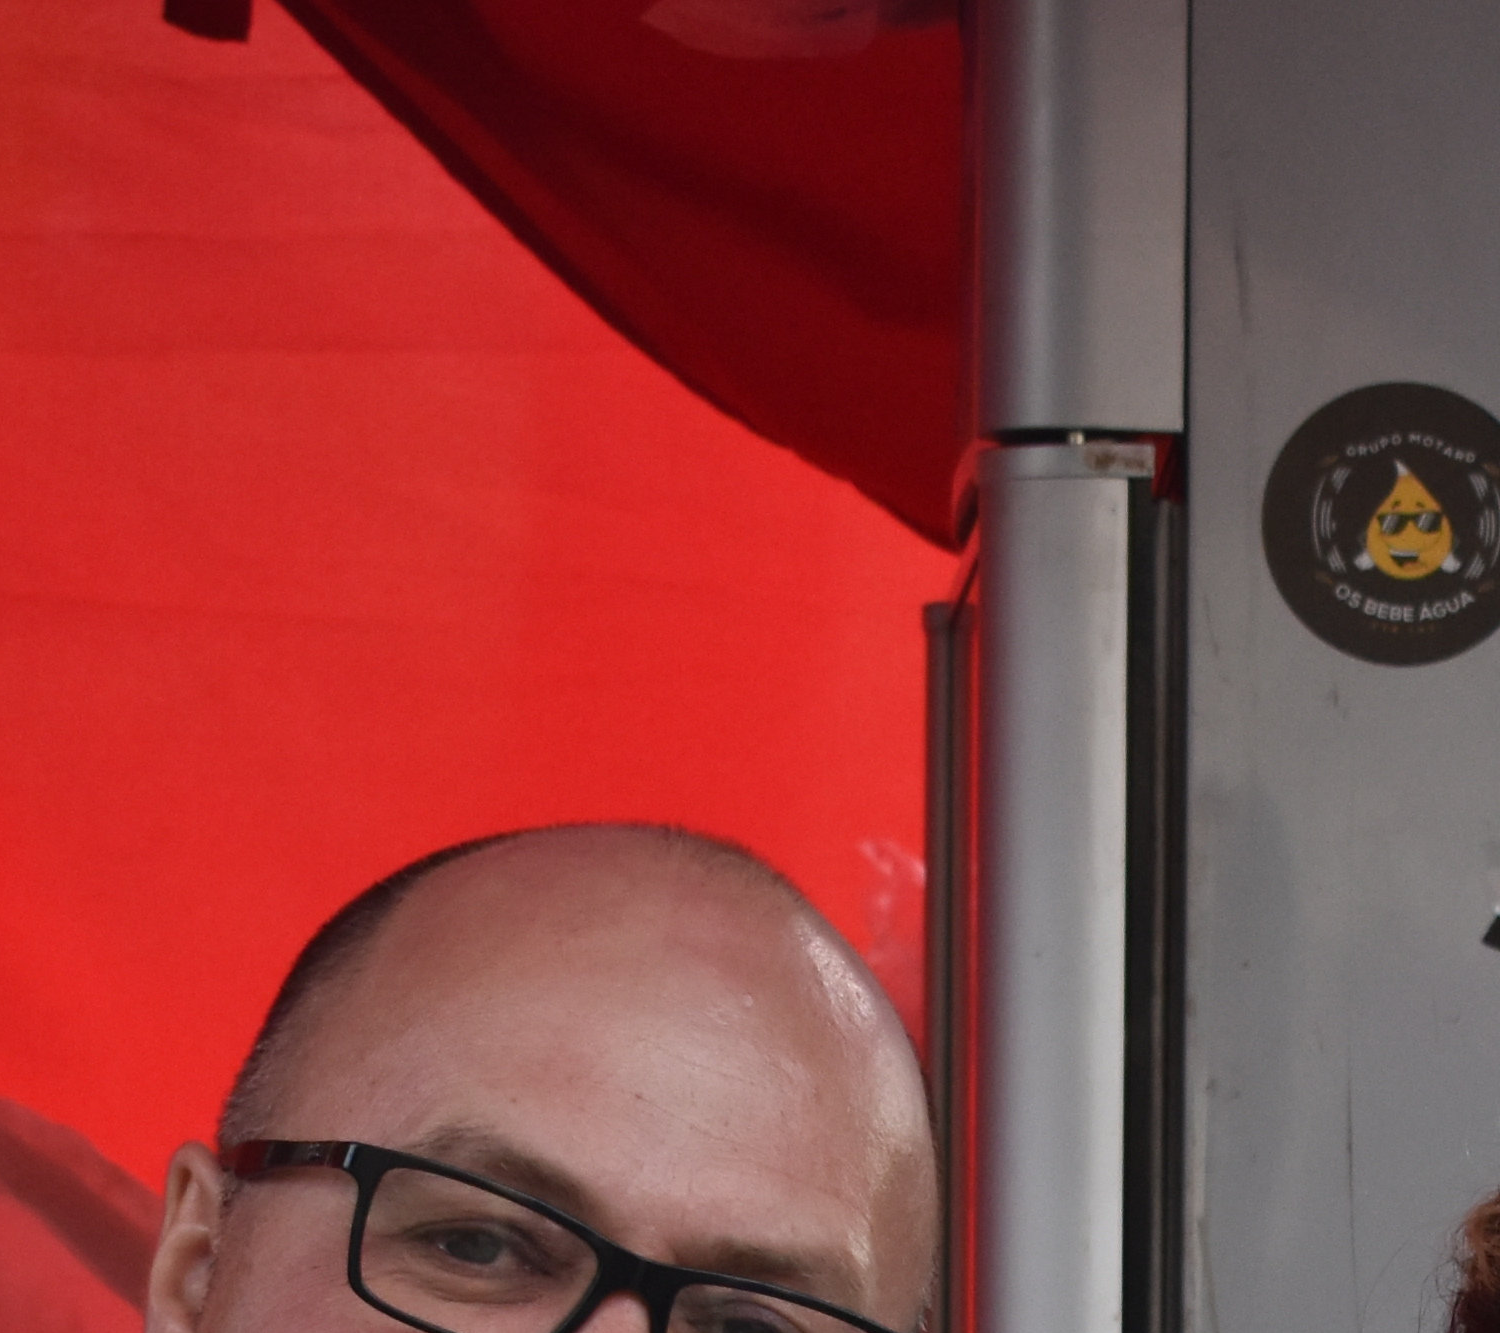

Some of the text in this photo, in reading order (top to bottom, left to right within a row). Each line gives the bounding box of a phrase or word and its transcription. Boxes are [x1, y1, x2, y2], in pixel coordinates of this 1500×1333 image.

[1346, 432, 1477, 464] GRUPO MOTARD
[1336, 584, 1415, 622] OS BEBE
